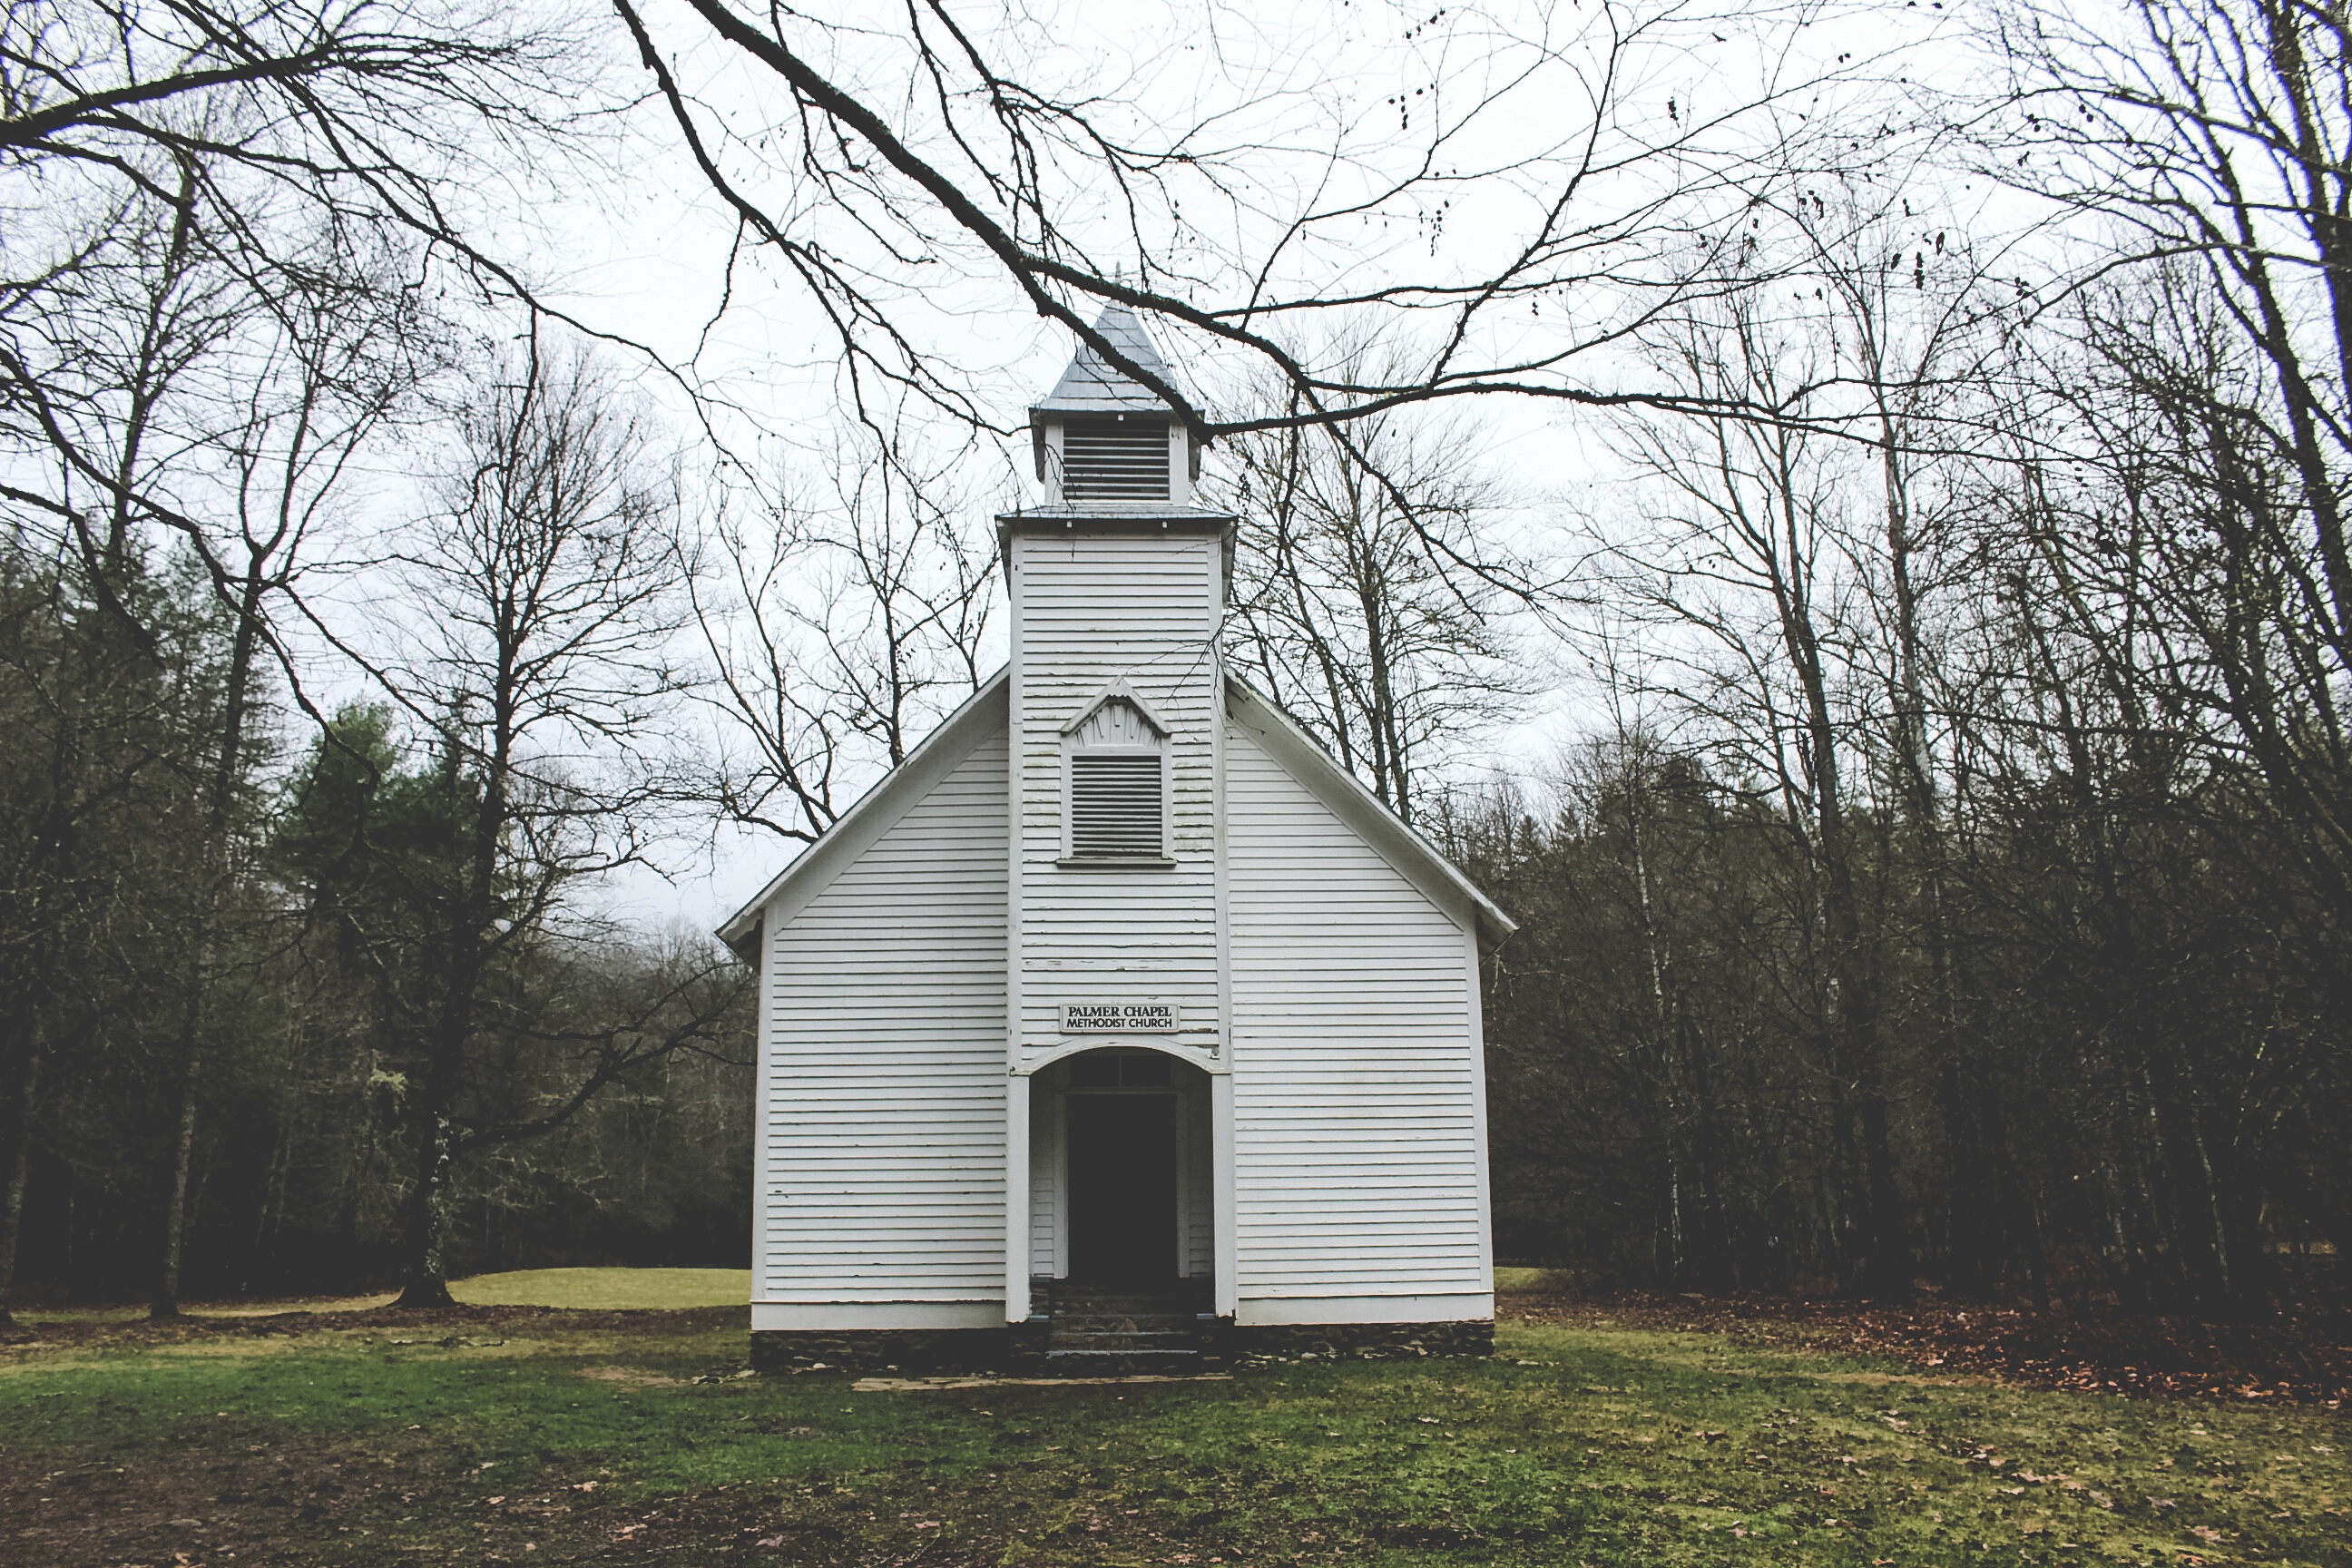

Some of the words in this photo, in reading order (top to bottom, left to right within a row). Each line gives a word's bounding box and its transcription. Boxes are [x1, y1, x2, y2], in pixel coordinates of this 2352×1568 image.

[1068, 1006, 1121, 1016] PALMER
[1123, 1006, 1171, 1016] CHAPEL
[1066, 1018, 1126, 1027] METHODIST
[1129, 1018, 1172, 1027] CHURCH
